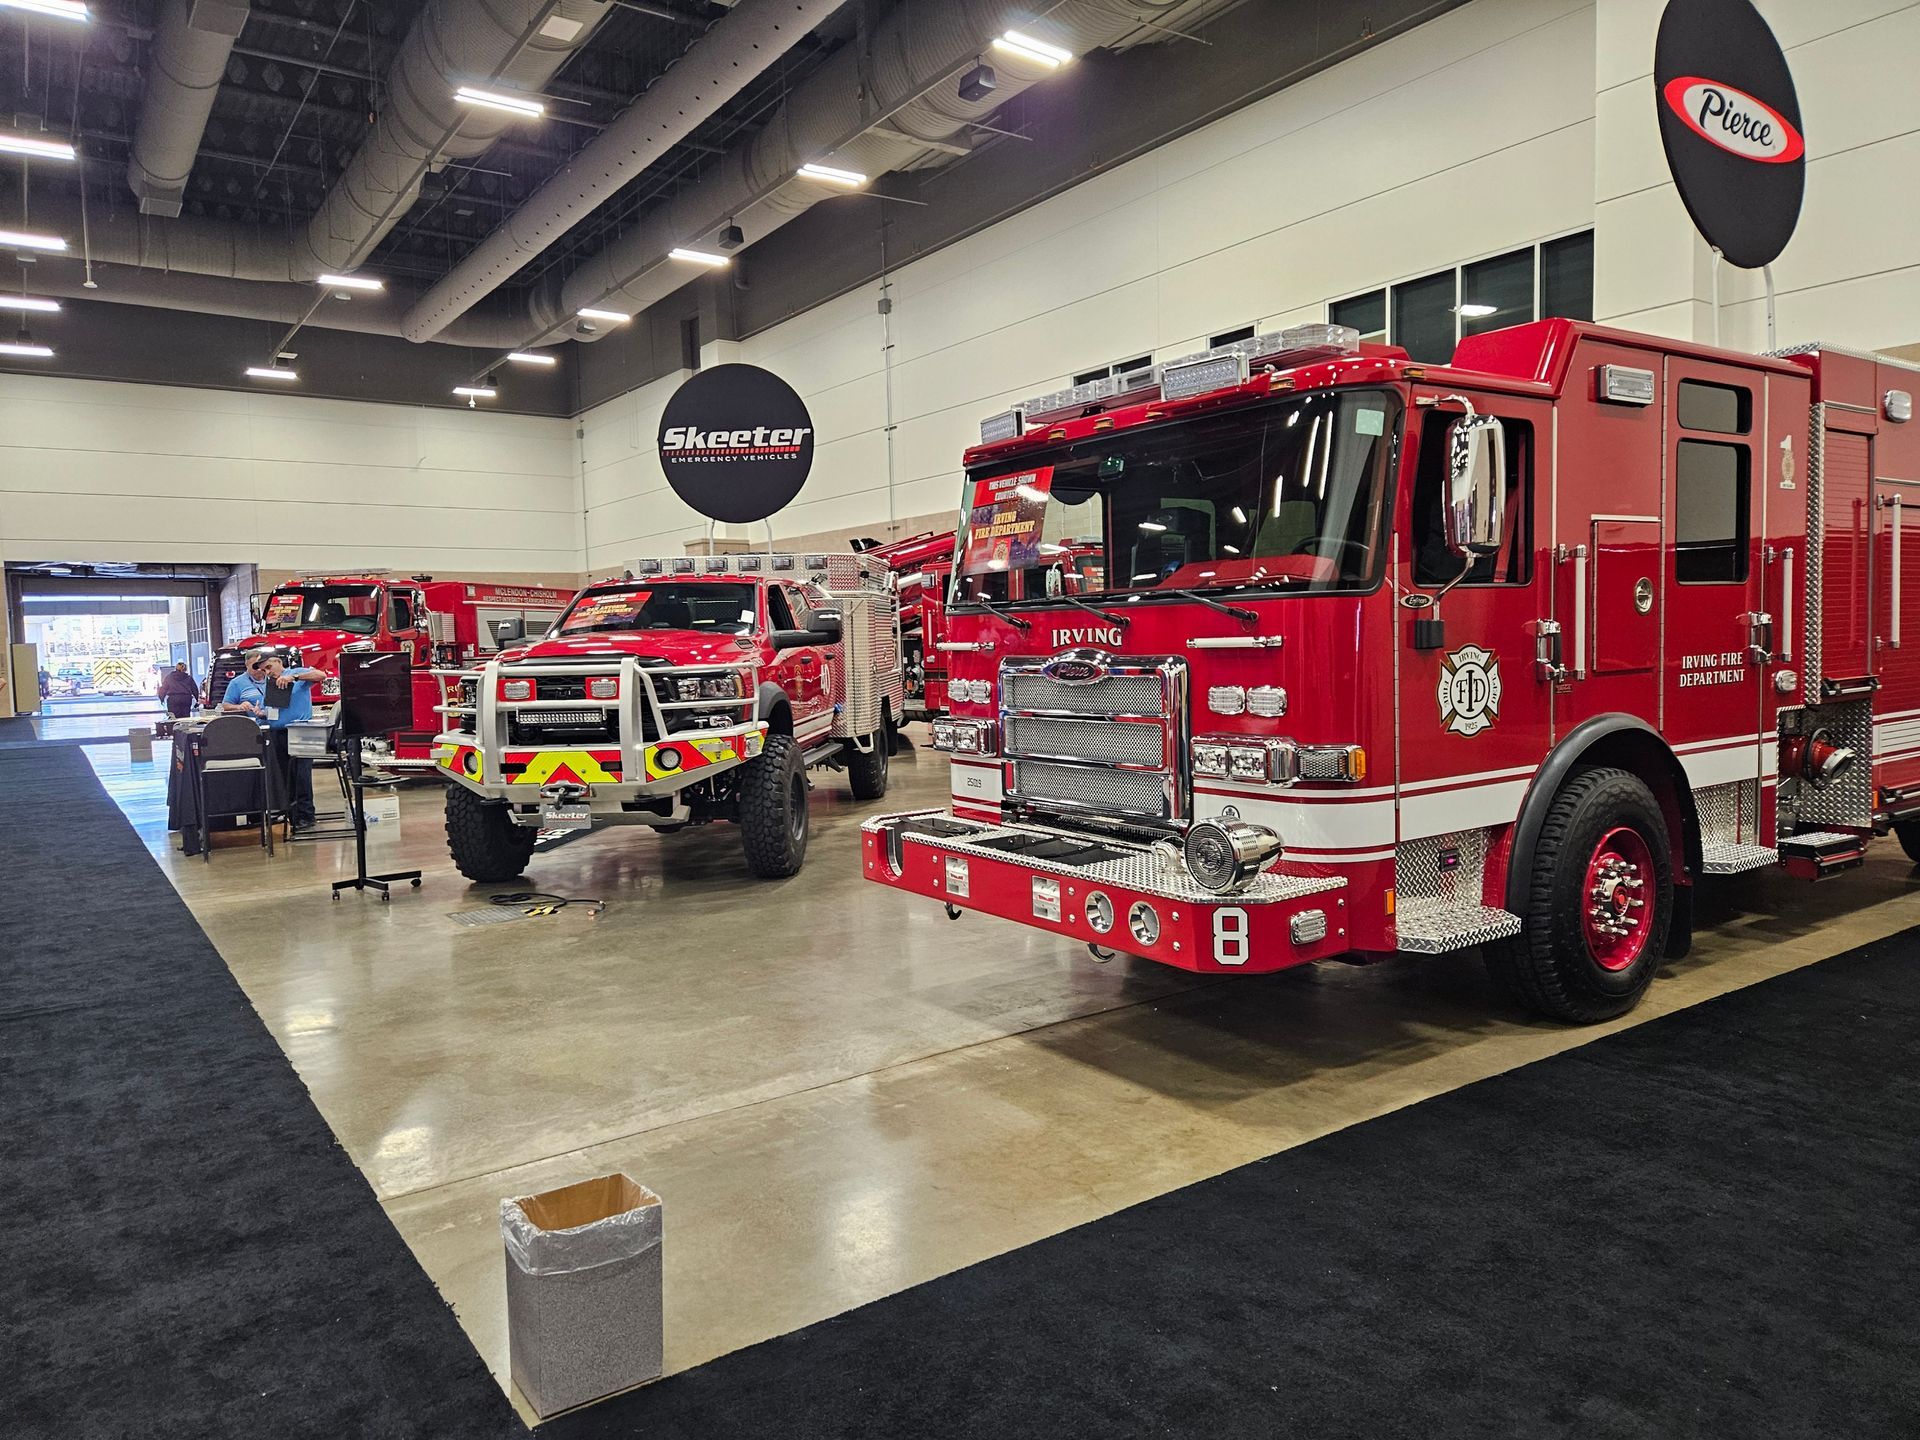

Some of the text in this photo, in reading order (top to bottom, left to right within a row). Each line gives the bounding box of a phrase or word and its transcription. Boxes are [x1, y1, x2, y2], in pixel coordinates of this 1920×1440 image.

[1698, 88, 1774, 147] Pierce
[663, 426, 811, 450] Skeeter
[671, 453, 798, 463] EMERGENCY VEHICLES
[993, 511, 1017, 525] IRVING
[974, 520, 1036, 540] FIRE DEPARTMENT
[1052, 627, 1122, 648] IRVING
[1459, 651, 1482, 663] IRVING
[1682, 652, 1743, 669] IRVING FIRE
[1679, 669, 1745, 687] DEPARTMENT
[545, 811, 589, 819] Skeeter
[1212, 906, 1249, 966] 8
